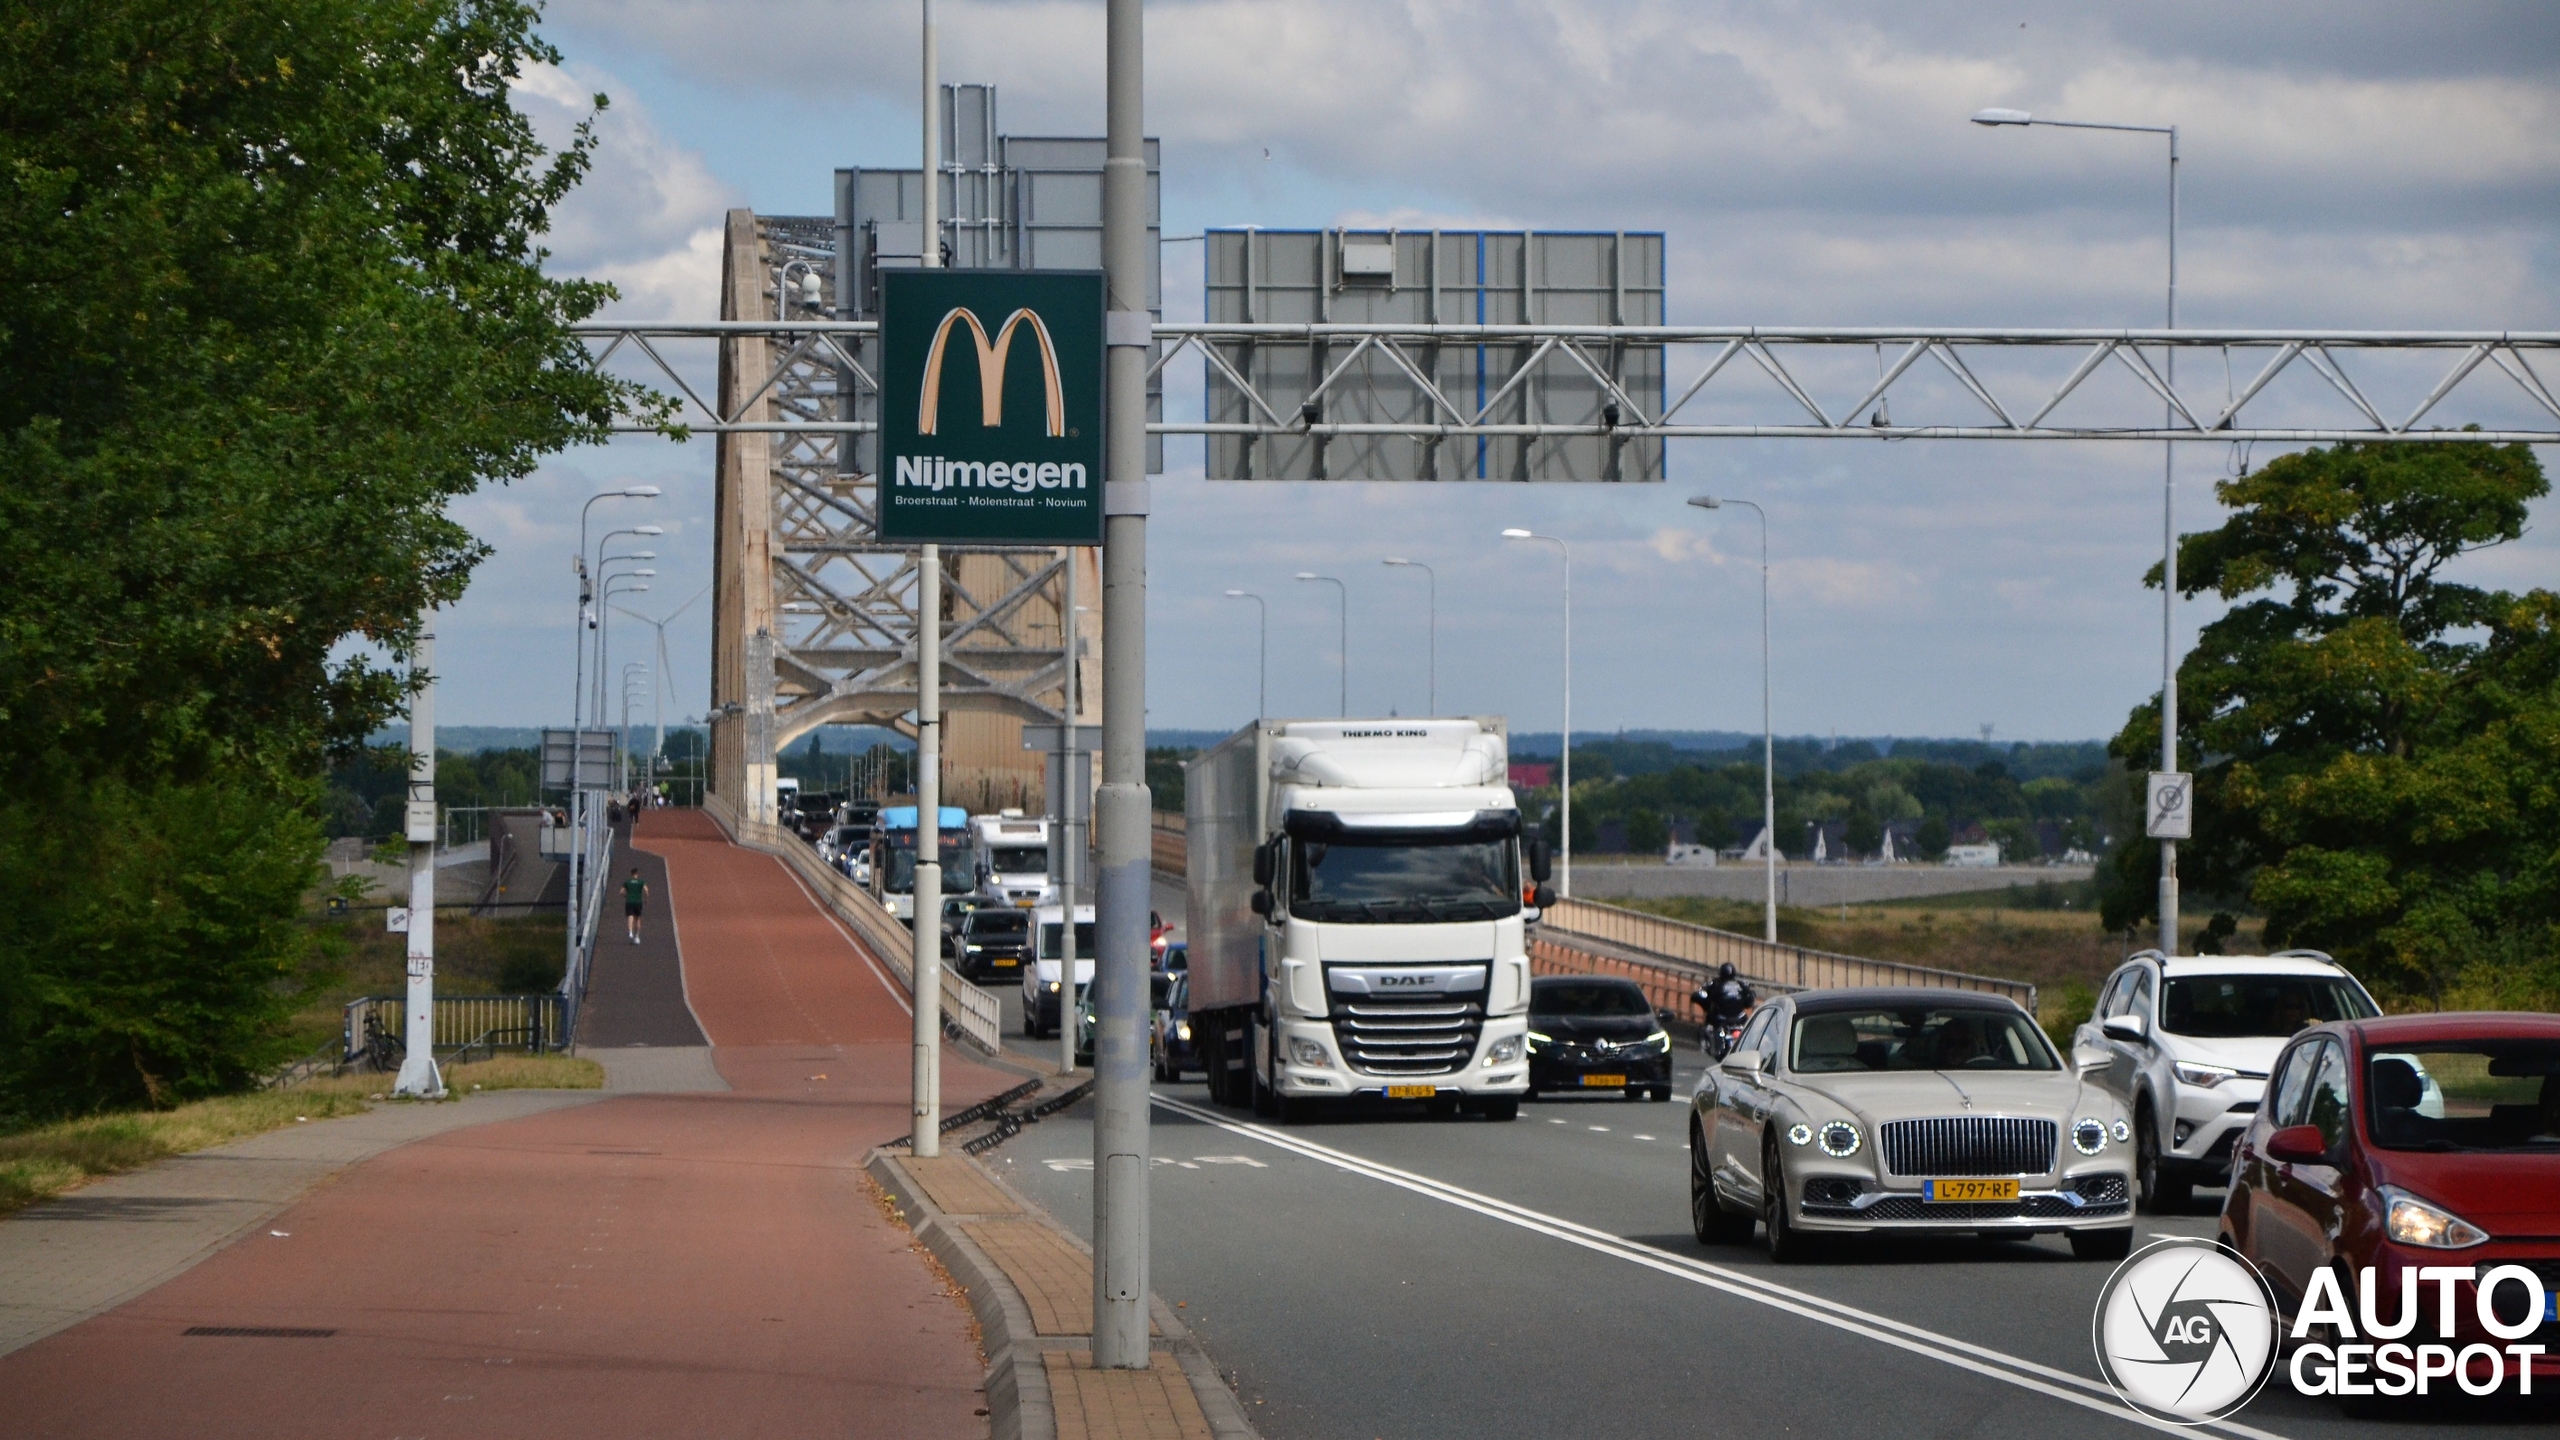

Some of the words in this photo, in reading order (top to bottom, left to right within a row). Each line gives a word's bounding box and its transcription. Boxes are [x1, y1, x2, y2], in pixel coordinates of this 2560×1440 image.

[895, 455, 1087, 493] Nijmegen
[895, 495, 958, 506] Broerstraat
[968, 496, 1035, 507] Molenstraat
[1045, 497, 1087, 508] Novium
[1342, 730, 1393, 738] THERMO
[1396, 729, 1428, 737] KING
[1379, 975, 1436, 987] DAF
[1942, 1182, 2012, 1198] L-797-RF
